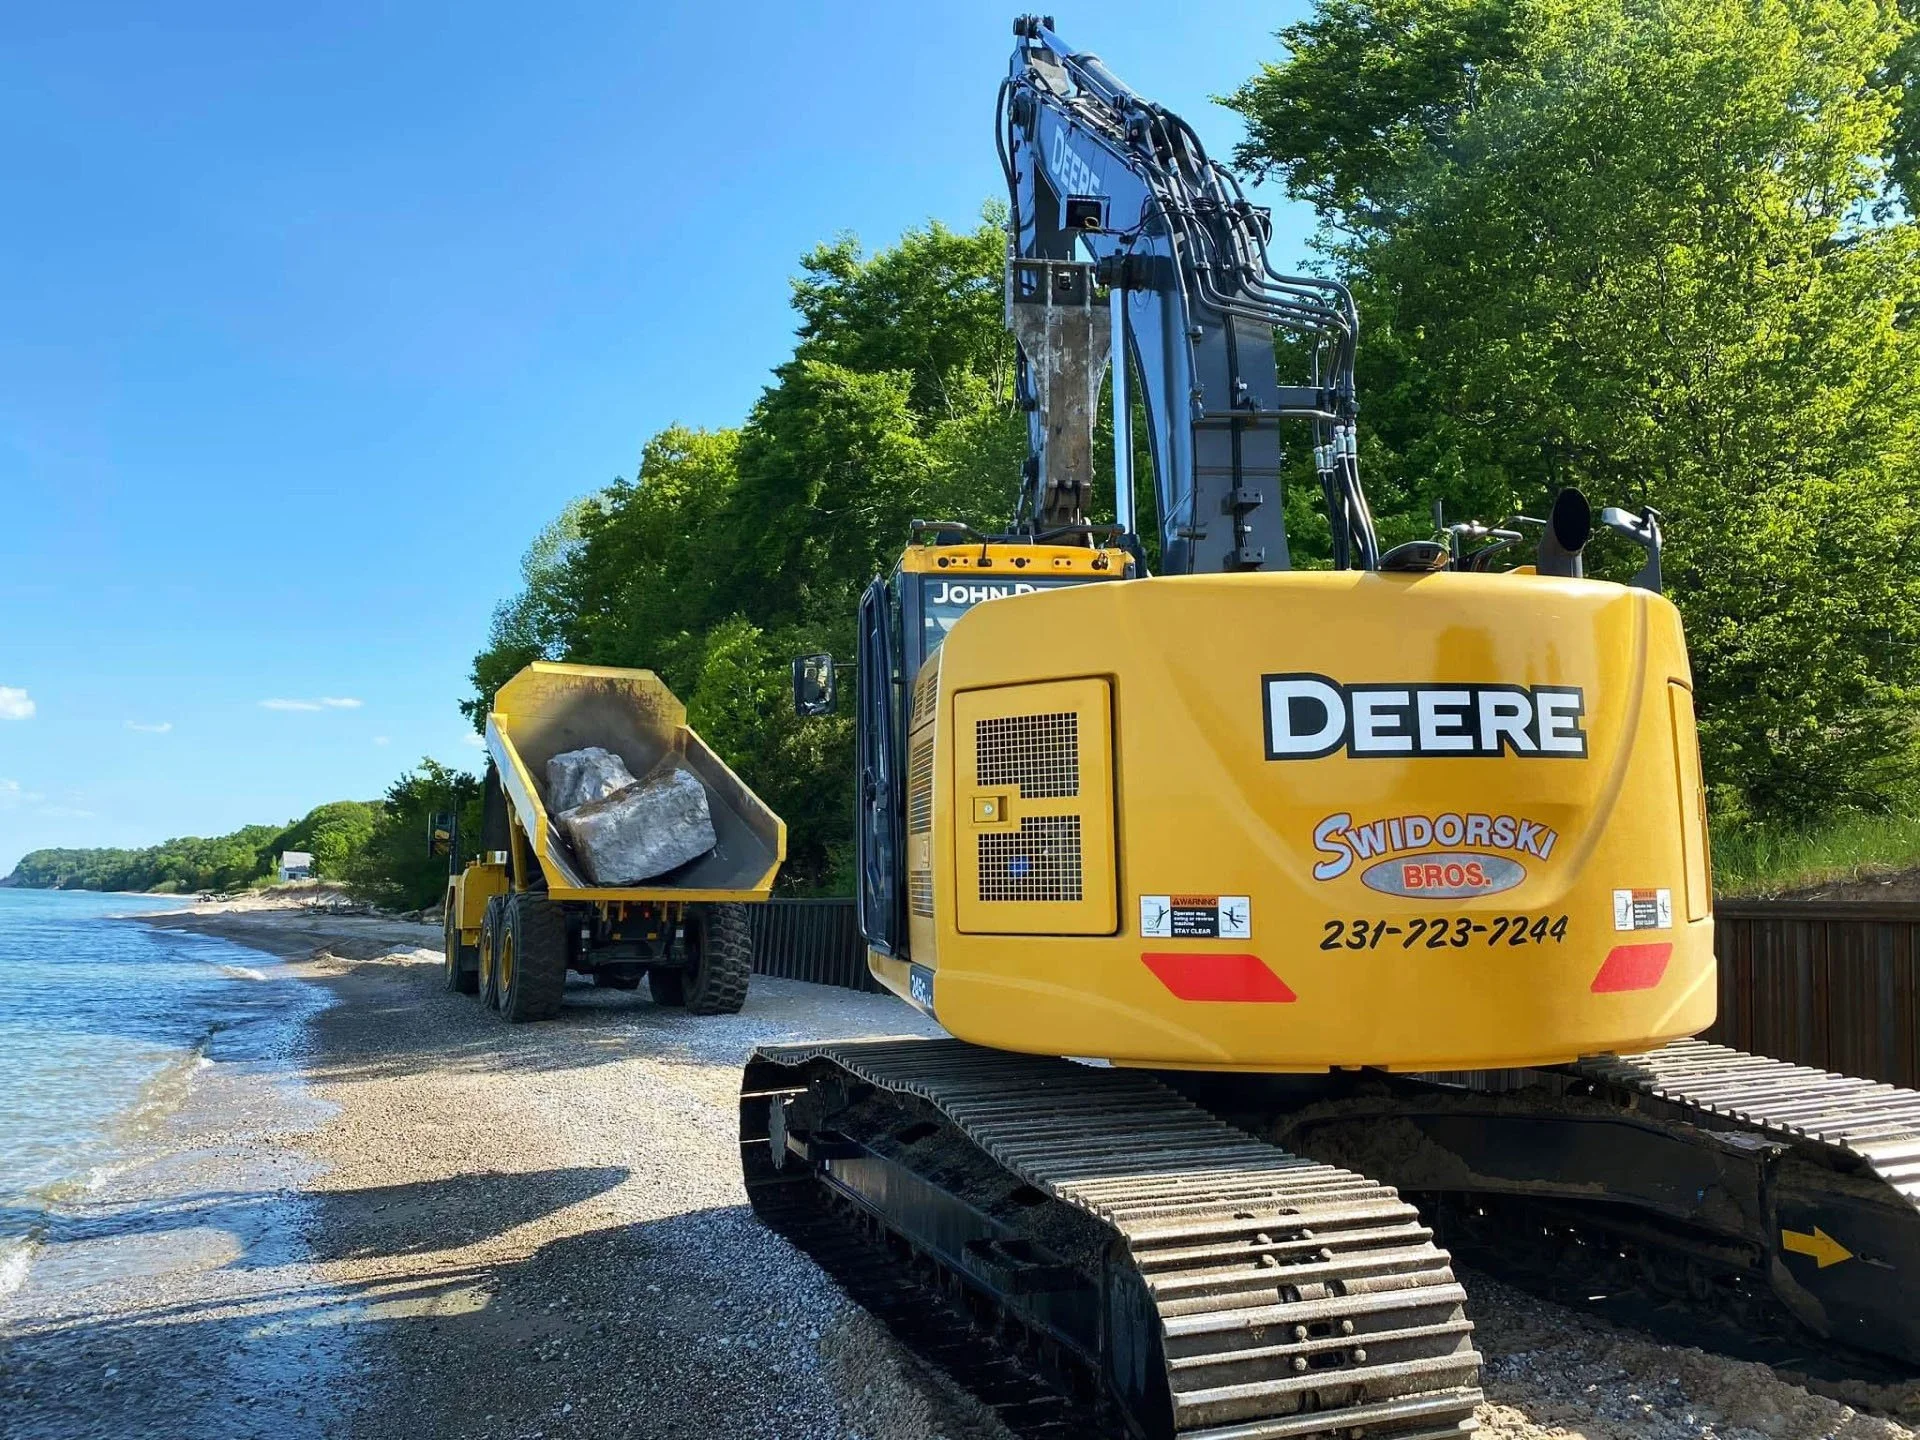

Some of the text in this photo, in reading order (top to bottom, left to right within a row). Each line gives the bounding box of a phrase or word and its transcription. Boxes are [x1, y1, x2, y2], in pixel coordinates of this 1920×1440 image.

[933, 582, 1008, 604] JOHN
[1265, 677, 1586, 757] DEERE
[1313, 812, 1558, 881] SWIDORSKI
[1402, 862, 1493, 889] BROS.
[1319, 915, 1569, 950] 231-723-7244
